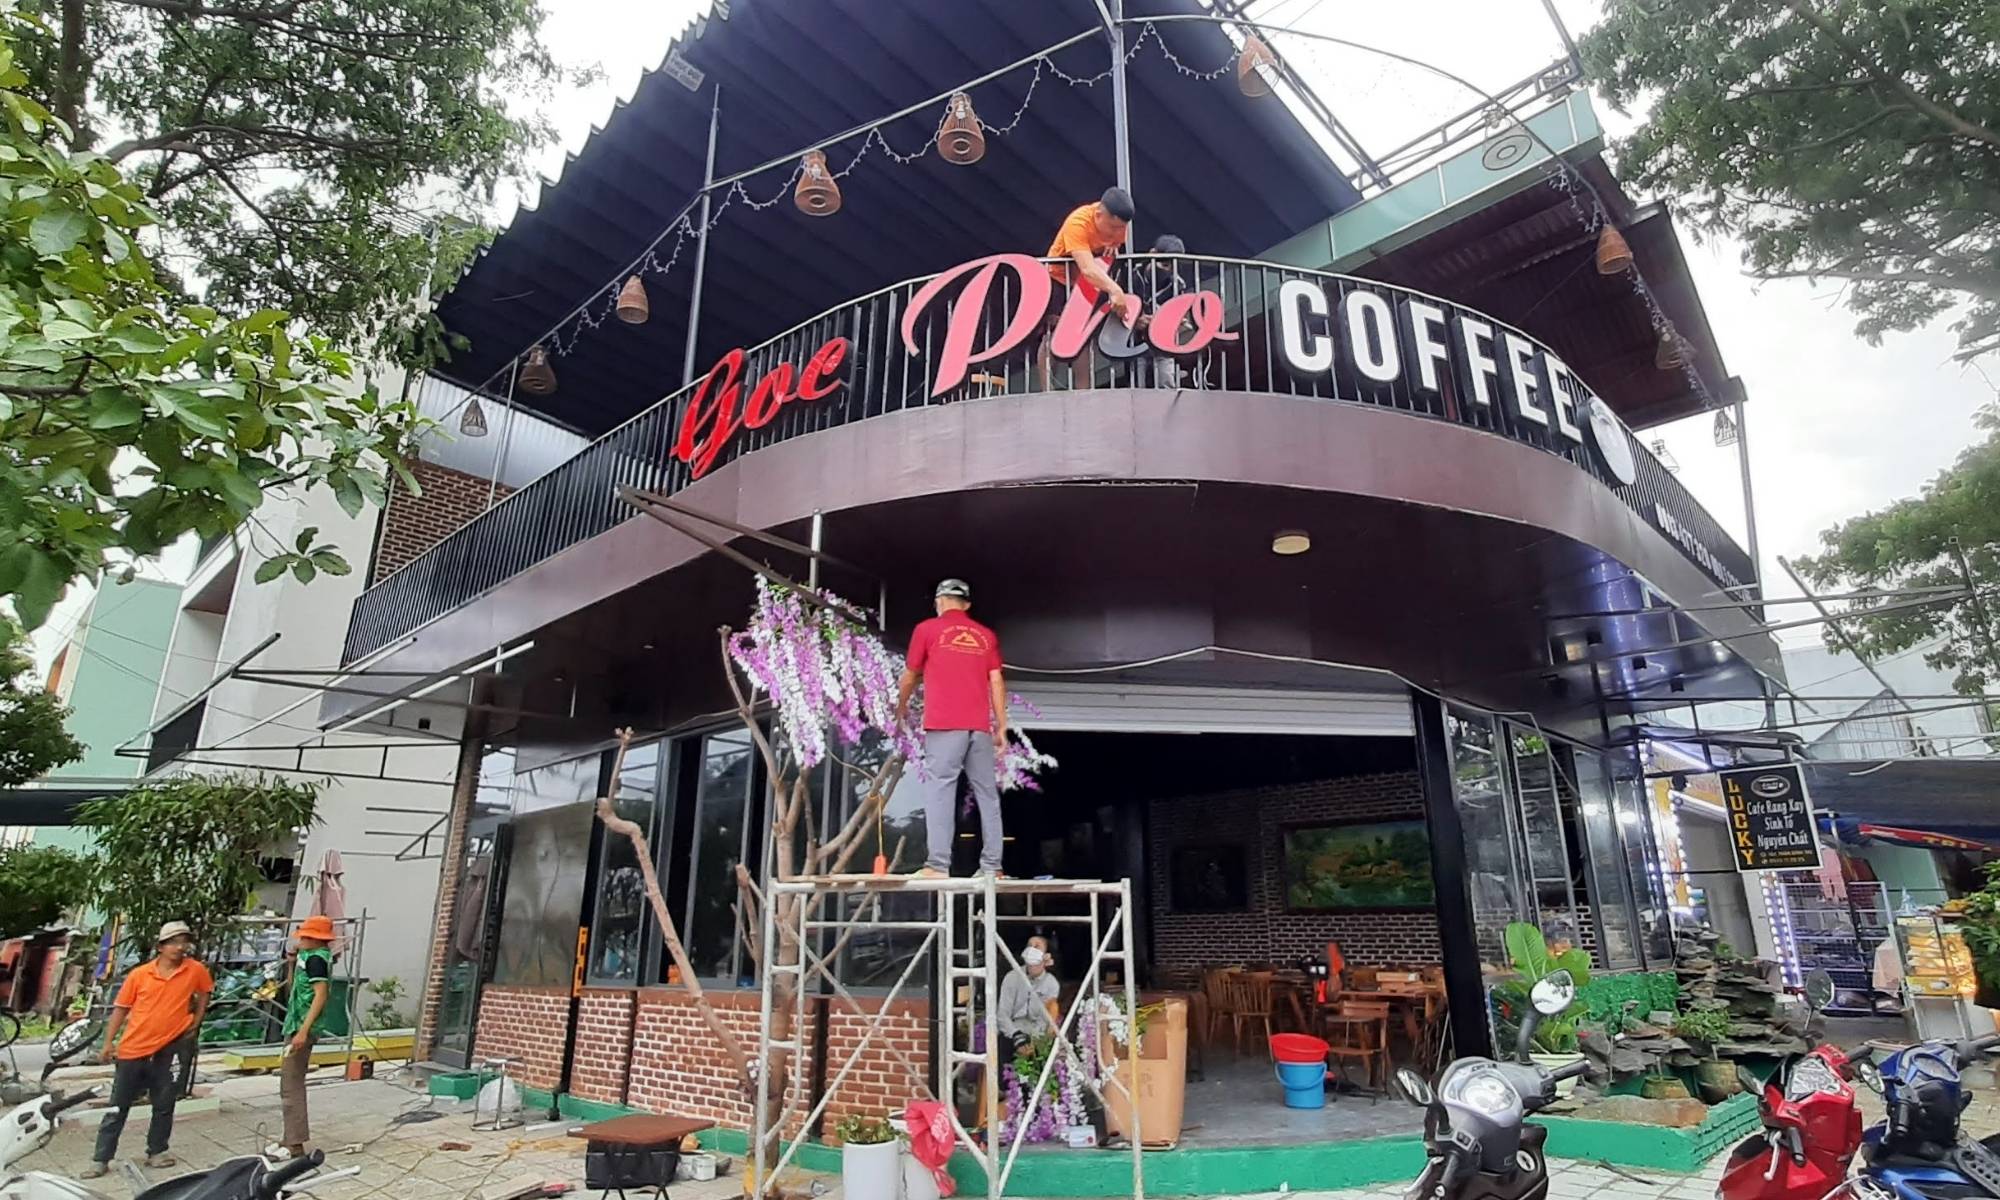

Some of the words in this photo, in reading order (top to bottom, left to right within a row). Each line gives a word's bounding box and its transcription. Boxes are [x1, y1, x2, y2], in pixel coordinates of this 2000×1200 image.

[1278, 279, 1582, 444] COFFEE
[1766, 799, 1787, 815] Rang
[1788, 798, 1804, 814] Xay
[1727, 778, 1754, 865] LUCKY
[1764, 816, 1783, 830] Sinh
[1789, 829, 1808, 845] Chất
